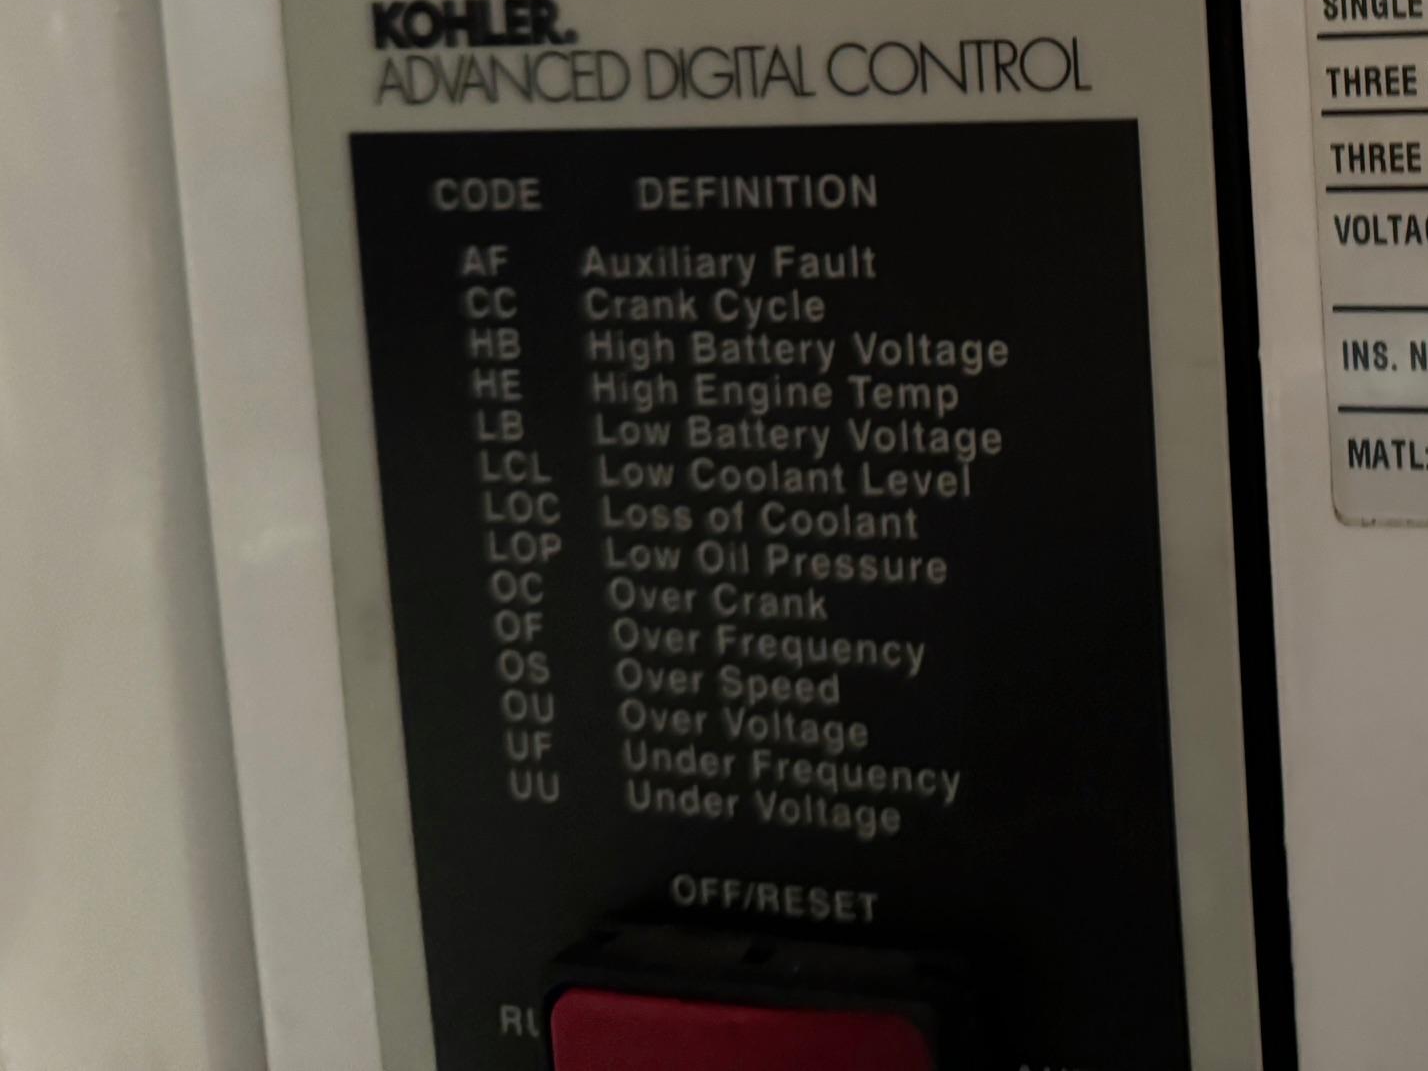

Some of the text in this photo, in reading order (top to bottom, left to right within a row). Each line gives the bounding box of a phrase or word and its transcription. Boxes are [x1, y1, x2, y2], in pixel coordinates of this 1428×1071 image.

[375, 36, 1092, 105] ADVANCED DIGITAL CONTROL
[1326, 64, 1419, 97] THREE
[1330, 141, 1422, 174] THREE
[434, 174, 878, 212] CODE DEFINITION
[462, 245, 876, 285] AF Auxiliary Fault
[466, 286, 826, 328] CC Crank Cycle
[589, 330, 1010, 375] High Battery Voltage
[1341, 342, 1397, 372] INS.
[697, 374, 960, 417] Engine Temp
[480, 450, 972, 498] LCL Low Coolant Level
[700, 540, 948, 584] Oil Pressure
[613, 618, 926, 676] Over Frequency
[720, 665, 841, 707] Speed
[627, 780, 901, 841] Under Voltage
[671, 873, 879, 923] OFF/RESET
